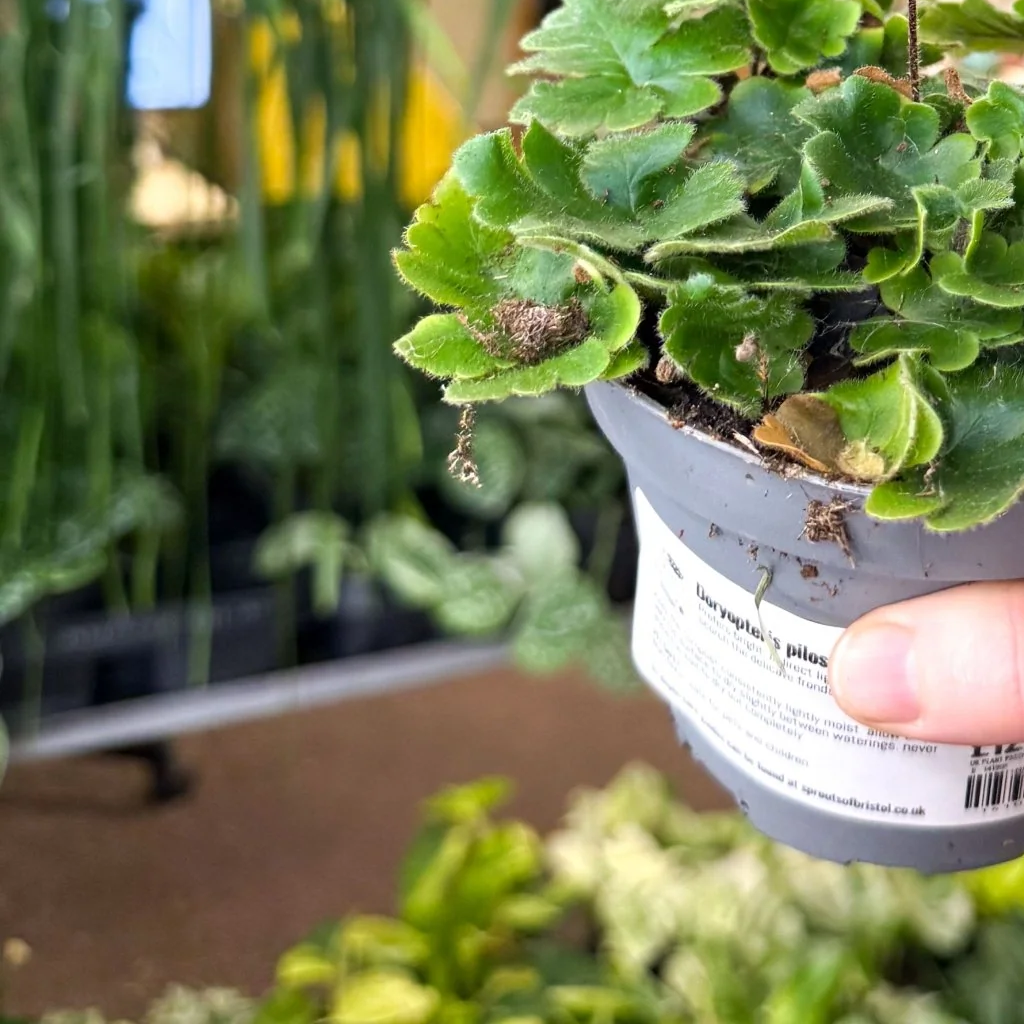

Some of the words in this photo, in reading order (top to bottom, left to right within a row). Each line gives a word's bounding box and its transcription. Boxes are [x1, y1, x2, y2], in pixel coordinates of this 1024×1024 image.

[786, 642, 829, 668] pilos
[779, 710, 830, 738] between
[902, 742, 938, 754] never
